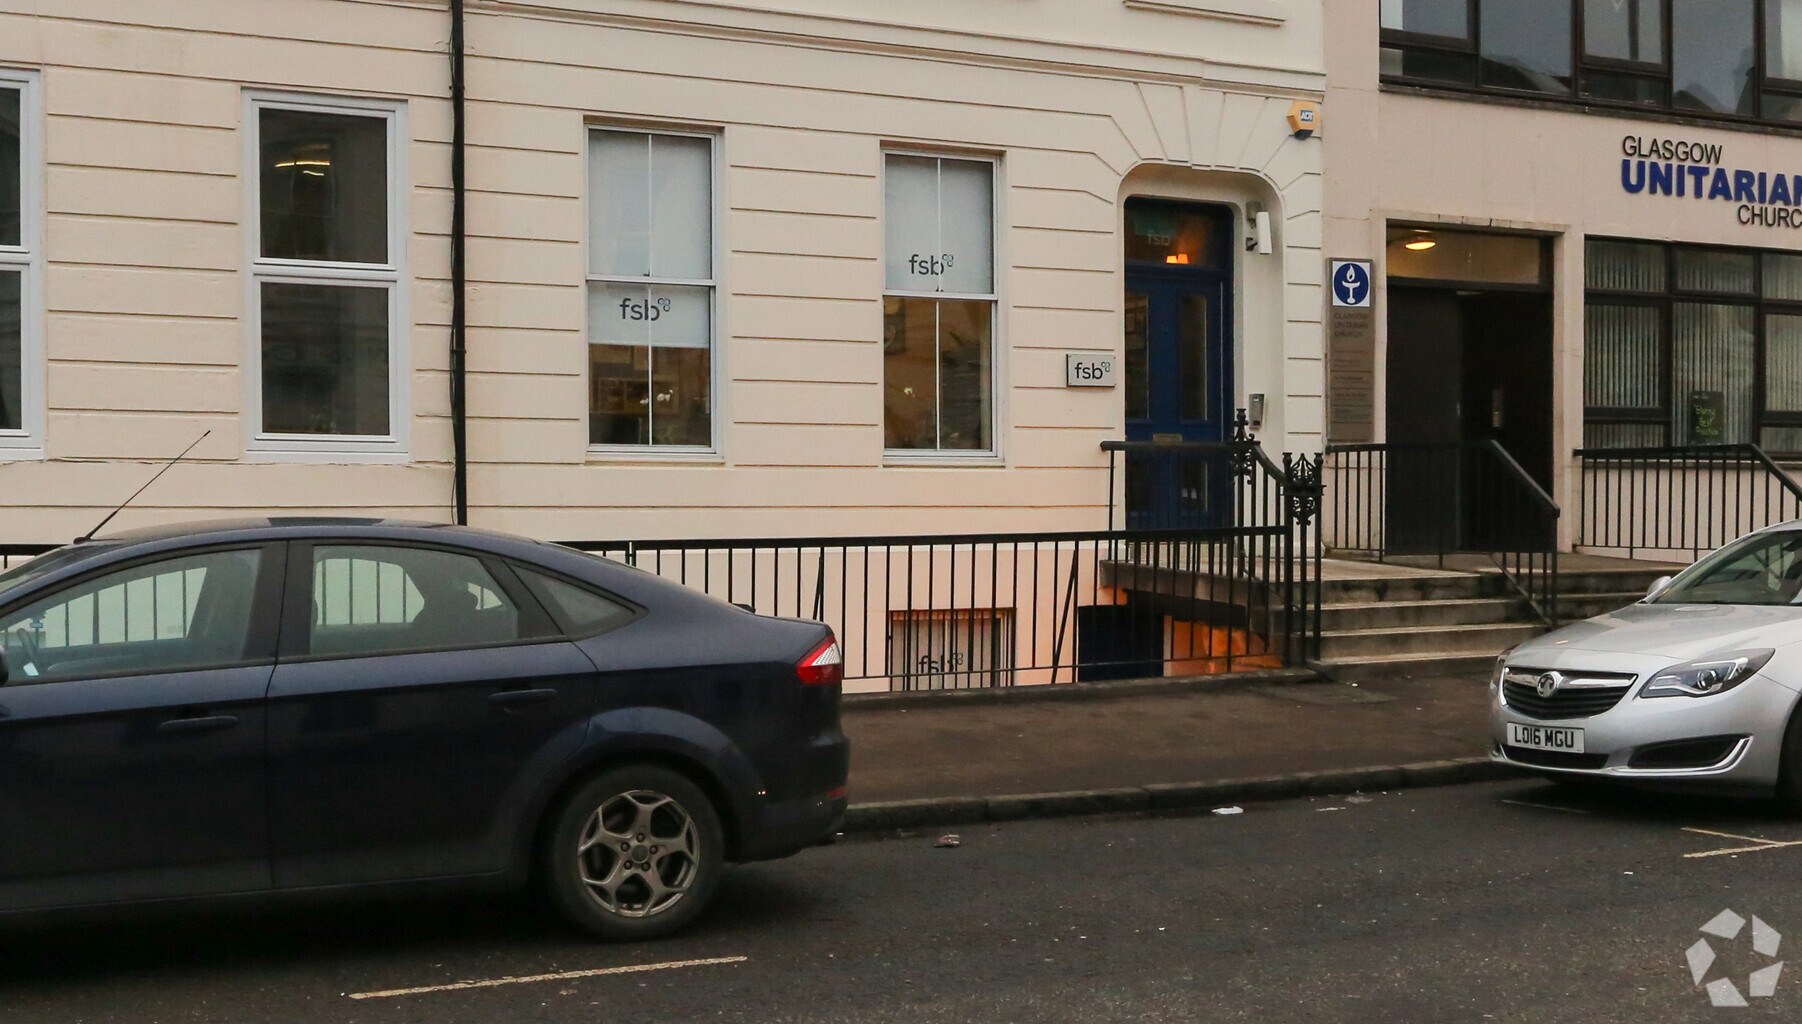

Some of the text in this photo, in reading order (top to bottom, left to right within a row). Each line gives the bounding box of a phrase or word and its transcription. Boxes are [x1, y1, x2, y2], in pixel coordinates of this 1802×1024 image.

[1622, 135, 1723, 165] GLASGOW
[1737, 204, 1802, 228] CHURC
[909, 253, 945, 276] fsb
[619, 297, 660, 321] fsb
[1074, 362, 1104, 380] fsb
[1514, 725, 1574, 748] LO16 MGU
